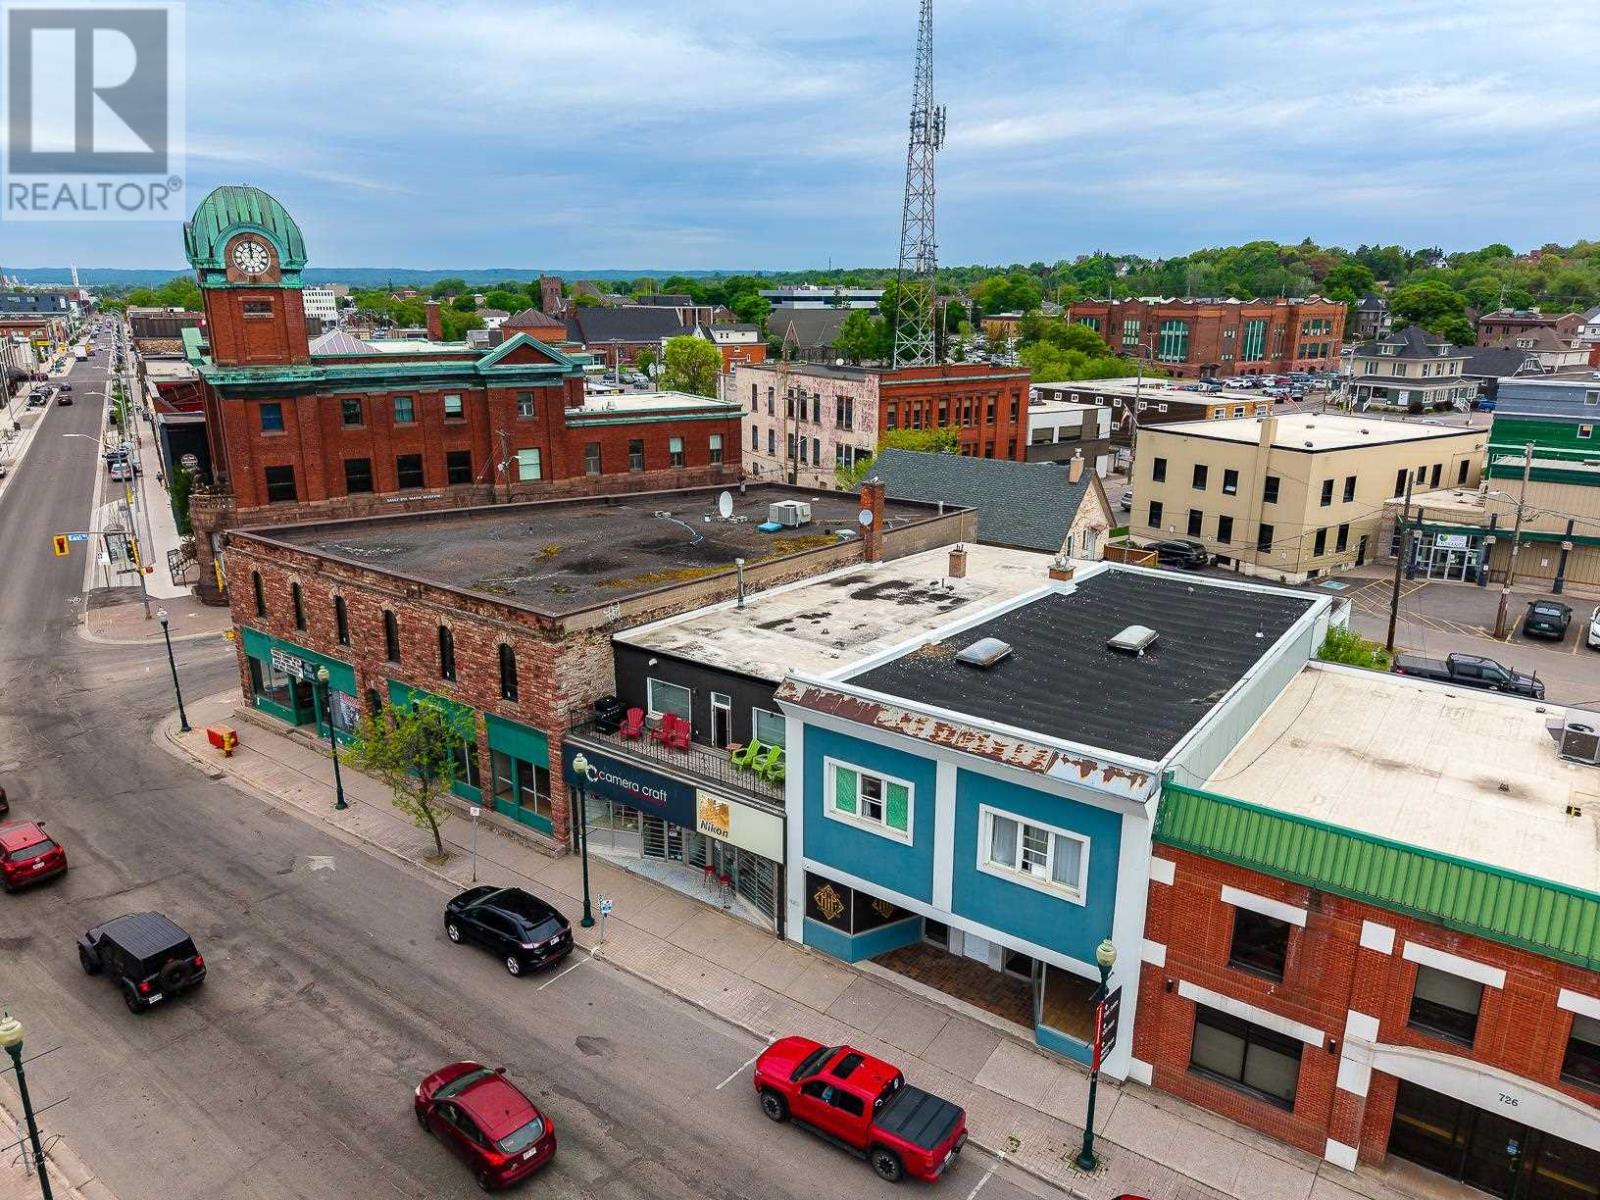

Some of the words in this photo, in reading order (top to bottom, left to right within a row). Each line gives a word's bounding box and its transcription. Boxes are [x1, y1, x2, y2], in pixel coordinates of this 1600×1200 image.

[599, 770, 639, 793] camera
[641, 786, 668, 802] craft
[700, 820, 729, 838] Nikon
[1499, 1093, 1519, 1107] 726
